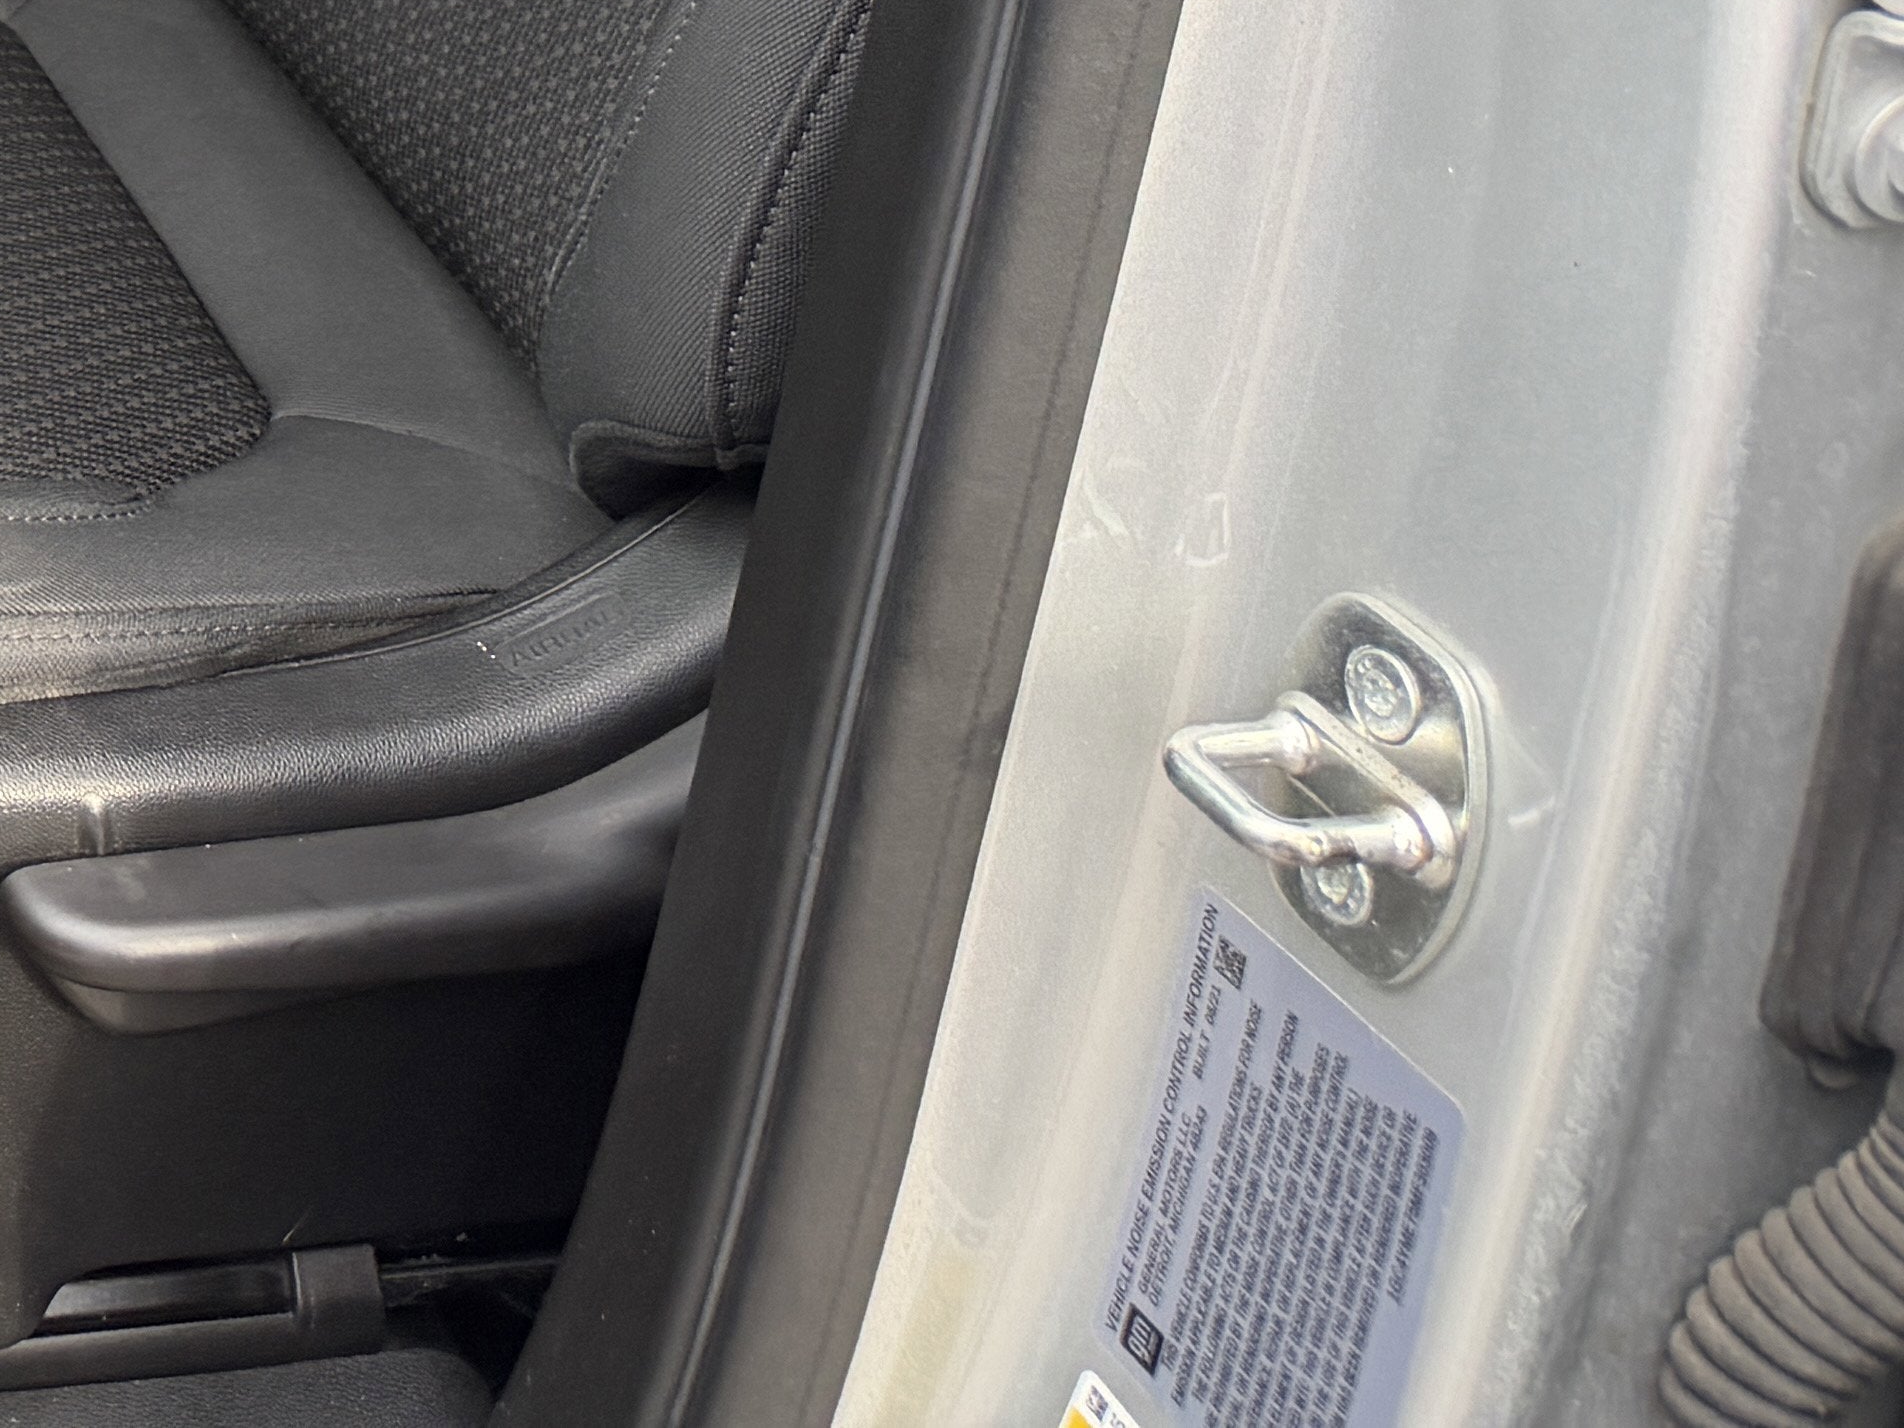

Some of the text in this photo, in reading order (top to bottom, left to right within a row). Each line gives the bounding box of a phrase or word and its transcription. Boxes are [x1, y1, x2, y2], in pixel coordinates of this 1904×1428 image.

[1242, 997, 1263, 1042] NOISE
[1274, 1007, 1299, 1066] PERSON
[1190, 1027, 1212, 1081] BUILT
[1236, 1036, 1253, 1069] FOR
[1269, 1059, 1287, 1094] ANY
[1287, 1065, 1305, 1098] THE
[1104, 900, 1222, 1335] VEHICLE NOISE EMISSION CONTROL INFORMATION
[1215, 1063, 1248, 1155] REGULATIONS
[1264, 1088, 1280, 1114] BY
[1306, 1147, 1325, 1181] ANY
[1322, 1046, 1350, 1115] CONTROL
[1229, 1130, 1251, 1179] HEAVY
[1250, 1106, 1276, 1171] THEREOF
[1270, 1144, 1286, 1171] OF
[1288, 1136, 1308, 1178] THAN
[1210, 1149, 1227, 1181] EPA
[1264, 1163, 1282, 1197] ACT
[1135, 1109, 1192, 1297] GENERAL MOTORS LLC
[1167, 1149, 1196, 1236] MICHIGAN
[1199, 1199, 1215, 1224] TO
[1222, 1172, 1240, 1207] AND
[1237, 1164, 1262, 1227] CAUSING
[1210, 1200, 1233, 1256] MEDIUM
[1230, 1221, 1247, 1252] THE
[1249, 1190, 1275, 1257] CONTROL
[1181, 1217, 1210, 1294] CONFORMS
[1205, 1248, 1221, 1273] TO
[1239, 1249, 1261, 1295] NOISE
[1185, 1267, 1216, 1351] APPLICABLE
[1217, 1267, 1236, 1307] ACTS
[1233, 1288, 1251, 1321] THE
[1167, 1285, 1192, 1344] VEHICLE
[1228, 1315, 1244, 1341] BY
[1197, 1300, 1227, 1380] FOLLOWING
[1170, 1342, 1196, 1409] EMISSION
[1190, 1371, 1208, 1405] THE
